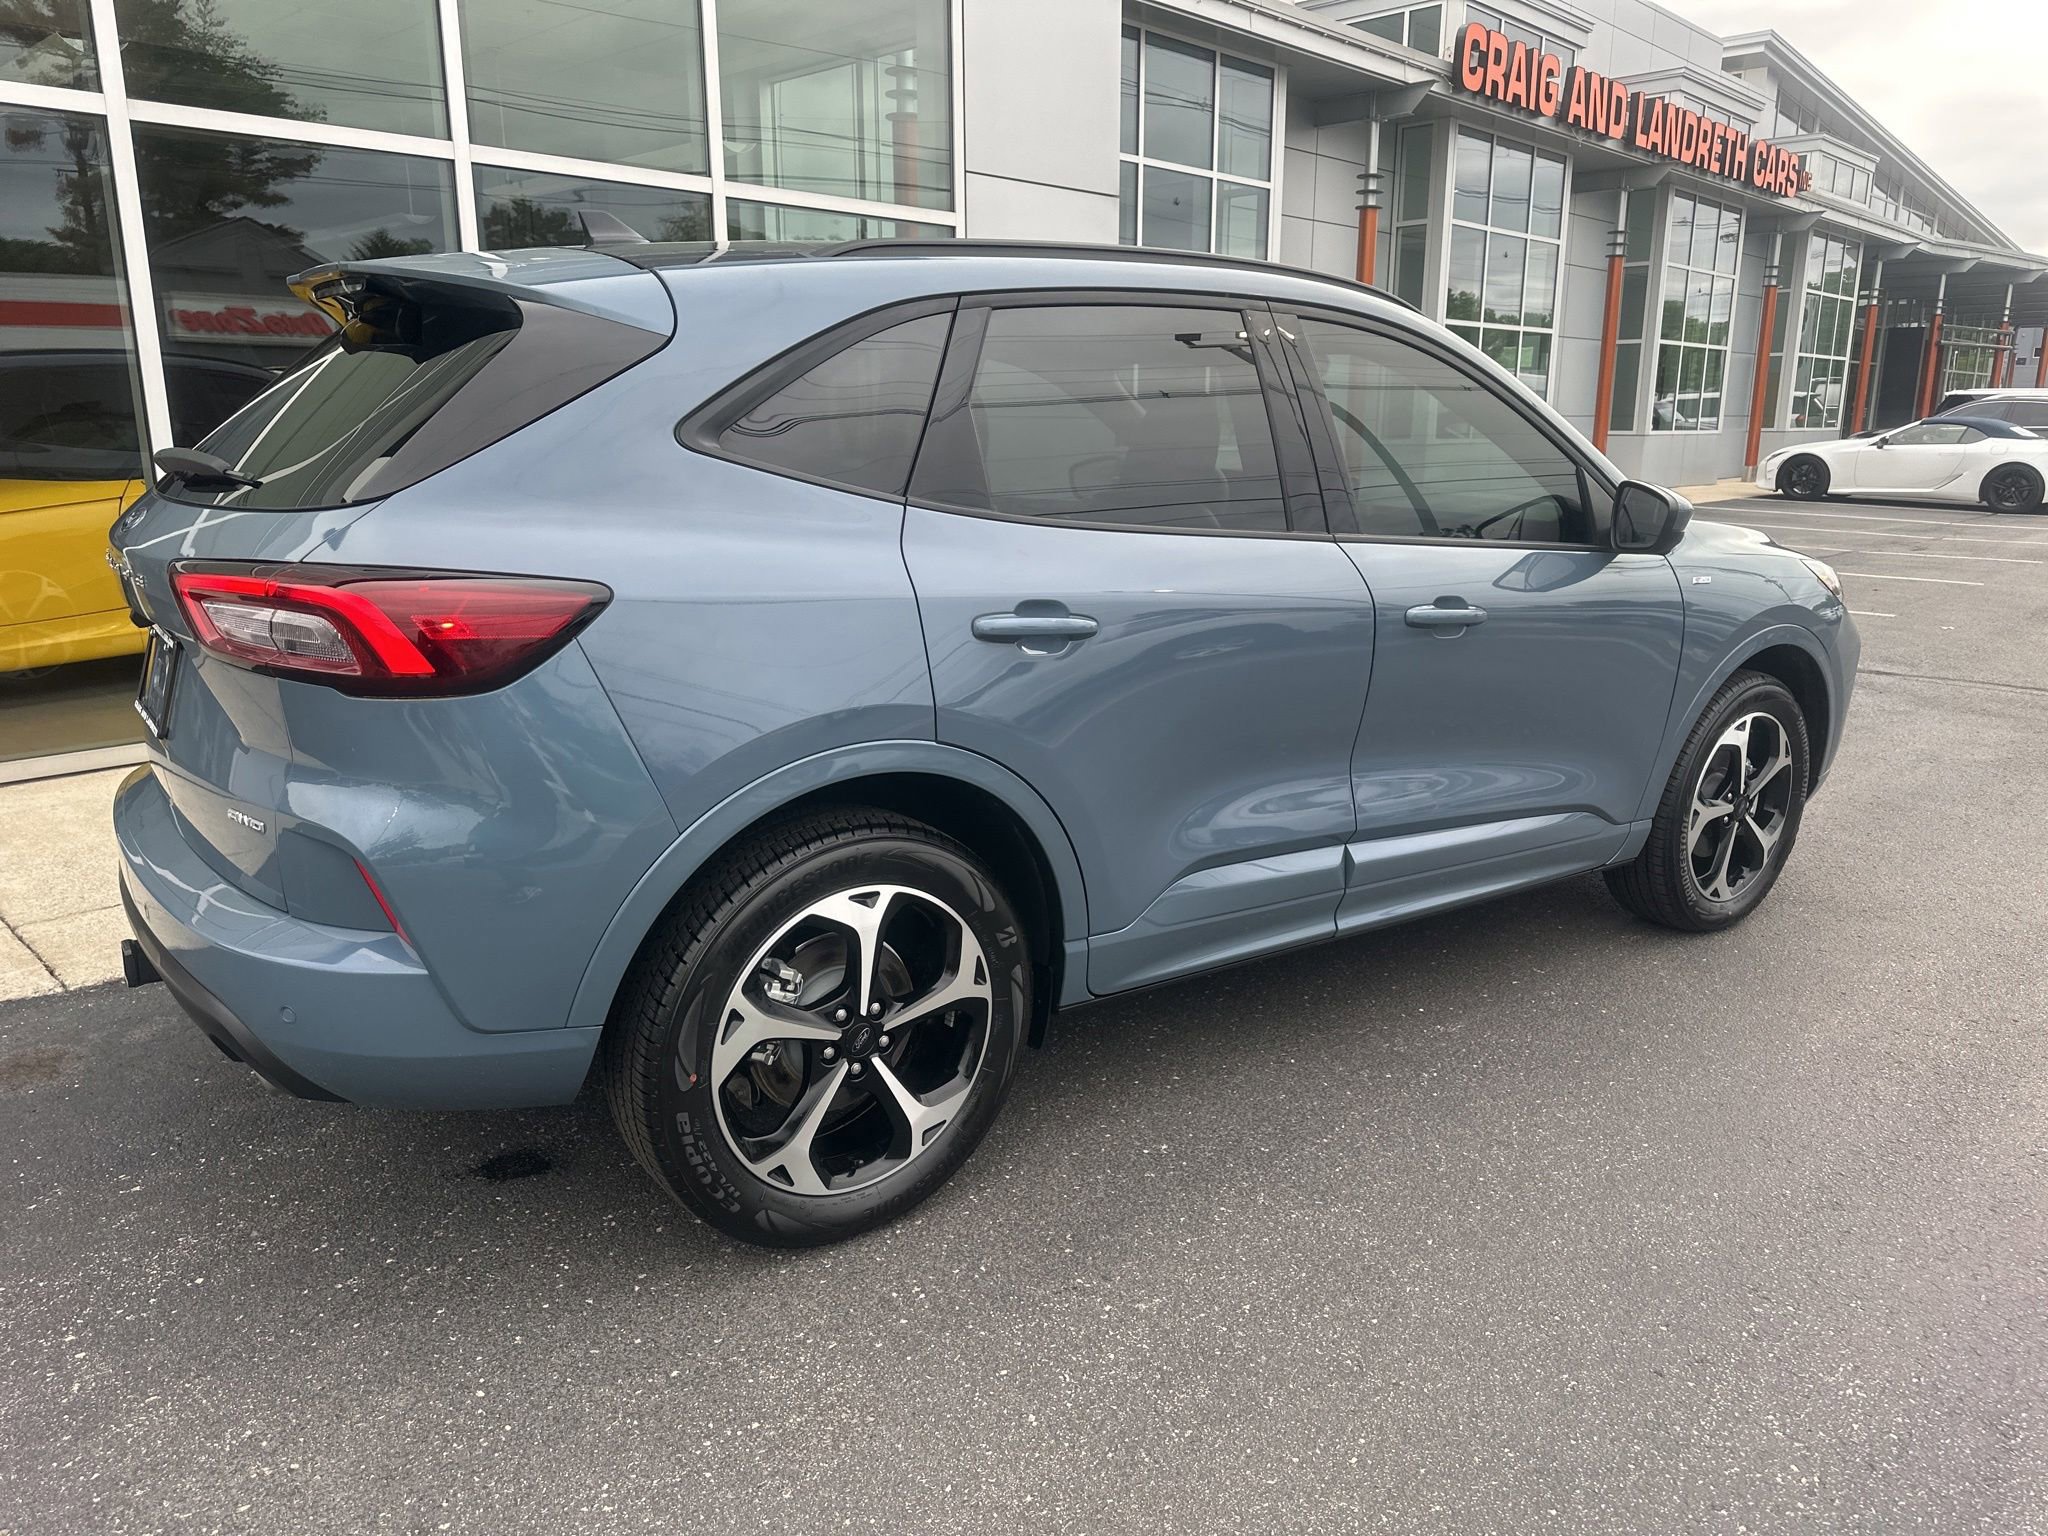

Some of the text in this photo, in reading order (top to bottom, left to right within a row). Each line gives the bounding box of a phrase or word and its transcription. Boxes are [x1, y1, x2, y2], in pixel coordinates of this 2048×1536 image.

[1462, 22, 1560, 117] CRAIG
[1567, 66, 1628, 140] AND
[1635, 91, 1750, 182] LANDRETH
[1753, 139, 1799, 198] CARS
[227, 808, 265, 834] AWD
